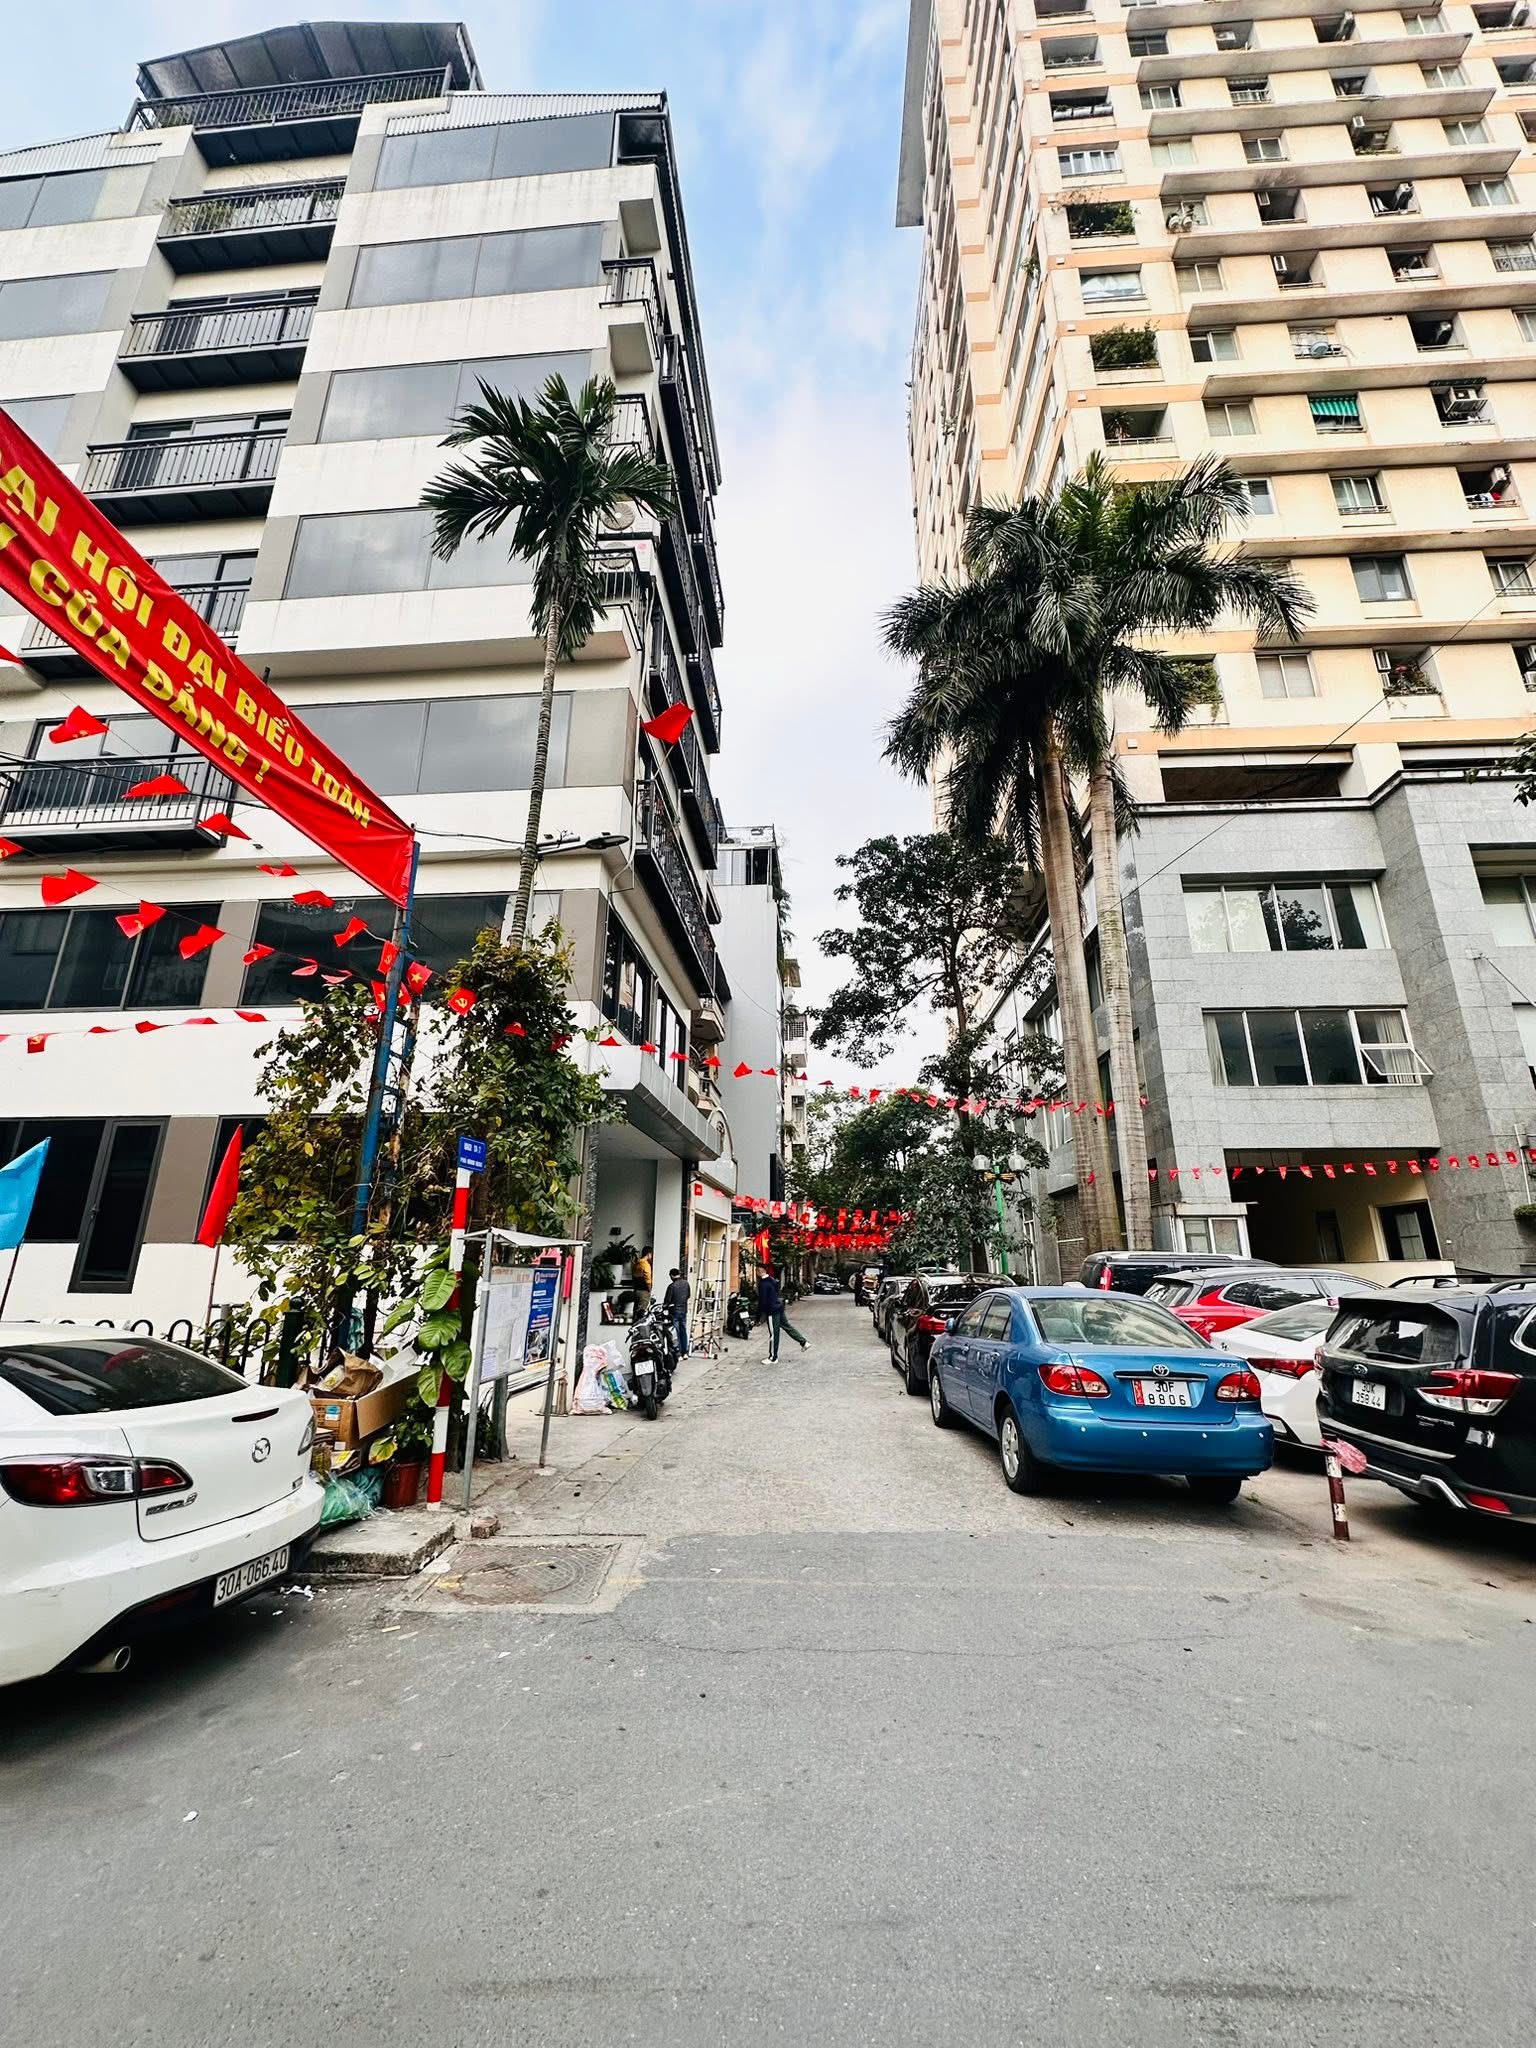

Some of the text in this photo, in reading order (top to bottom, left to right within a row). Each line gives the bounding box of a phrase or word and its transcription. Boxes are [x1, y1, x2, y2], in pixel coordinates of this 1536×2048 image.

[0, 463, 372, 829] ẠI HỘI ĐẠI BIỂU TOÀN
[29, 559, 131, 670] CỦA
[141, 659, 250, 767] ĐẢNG
[217, 1549, 288, 1601] 30A-066.40
